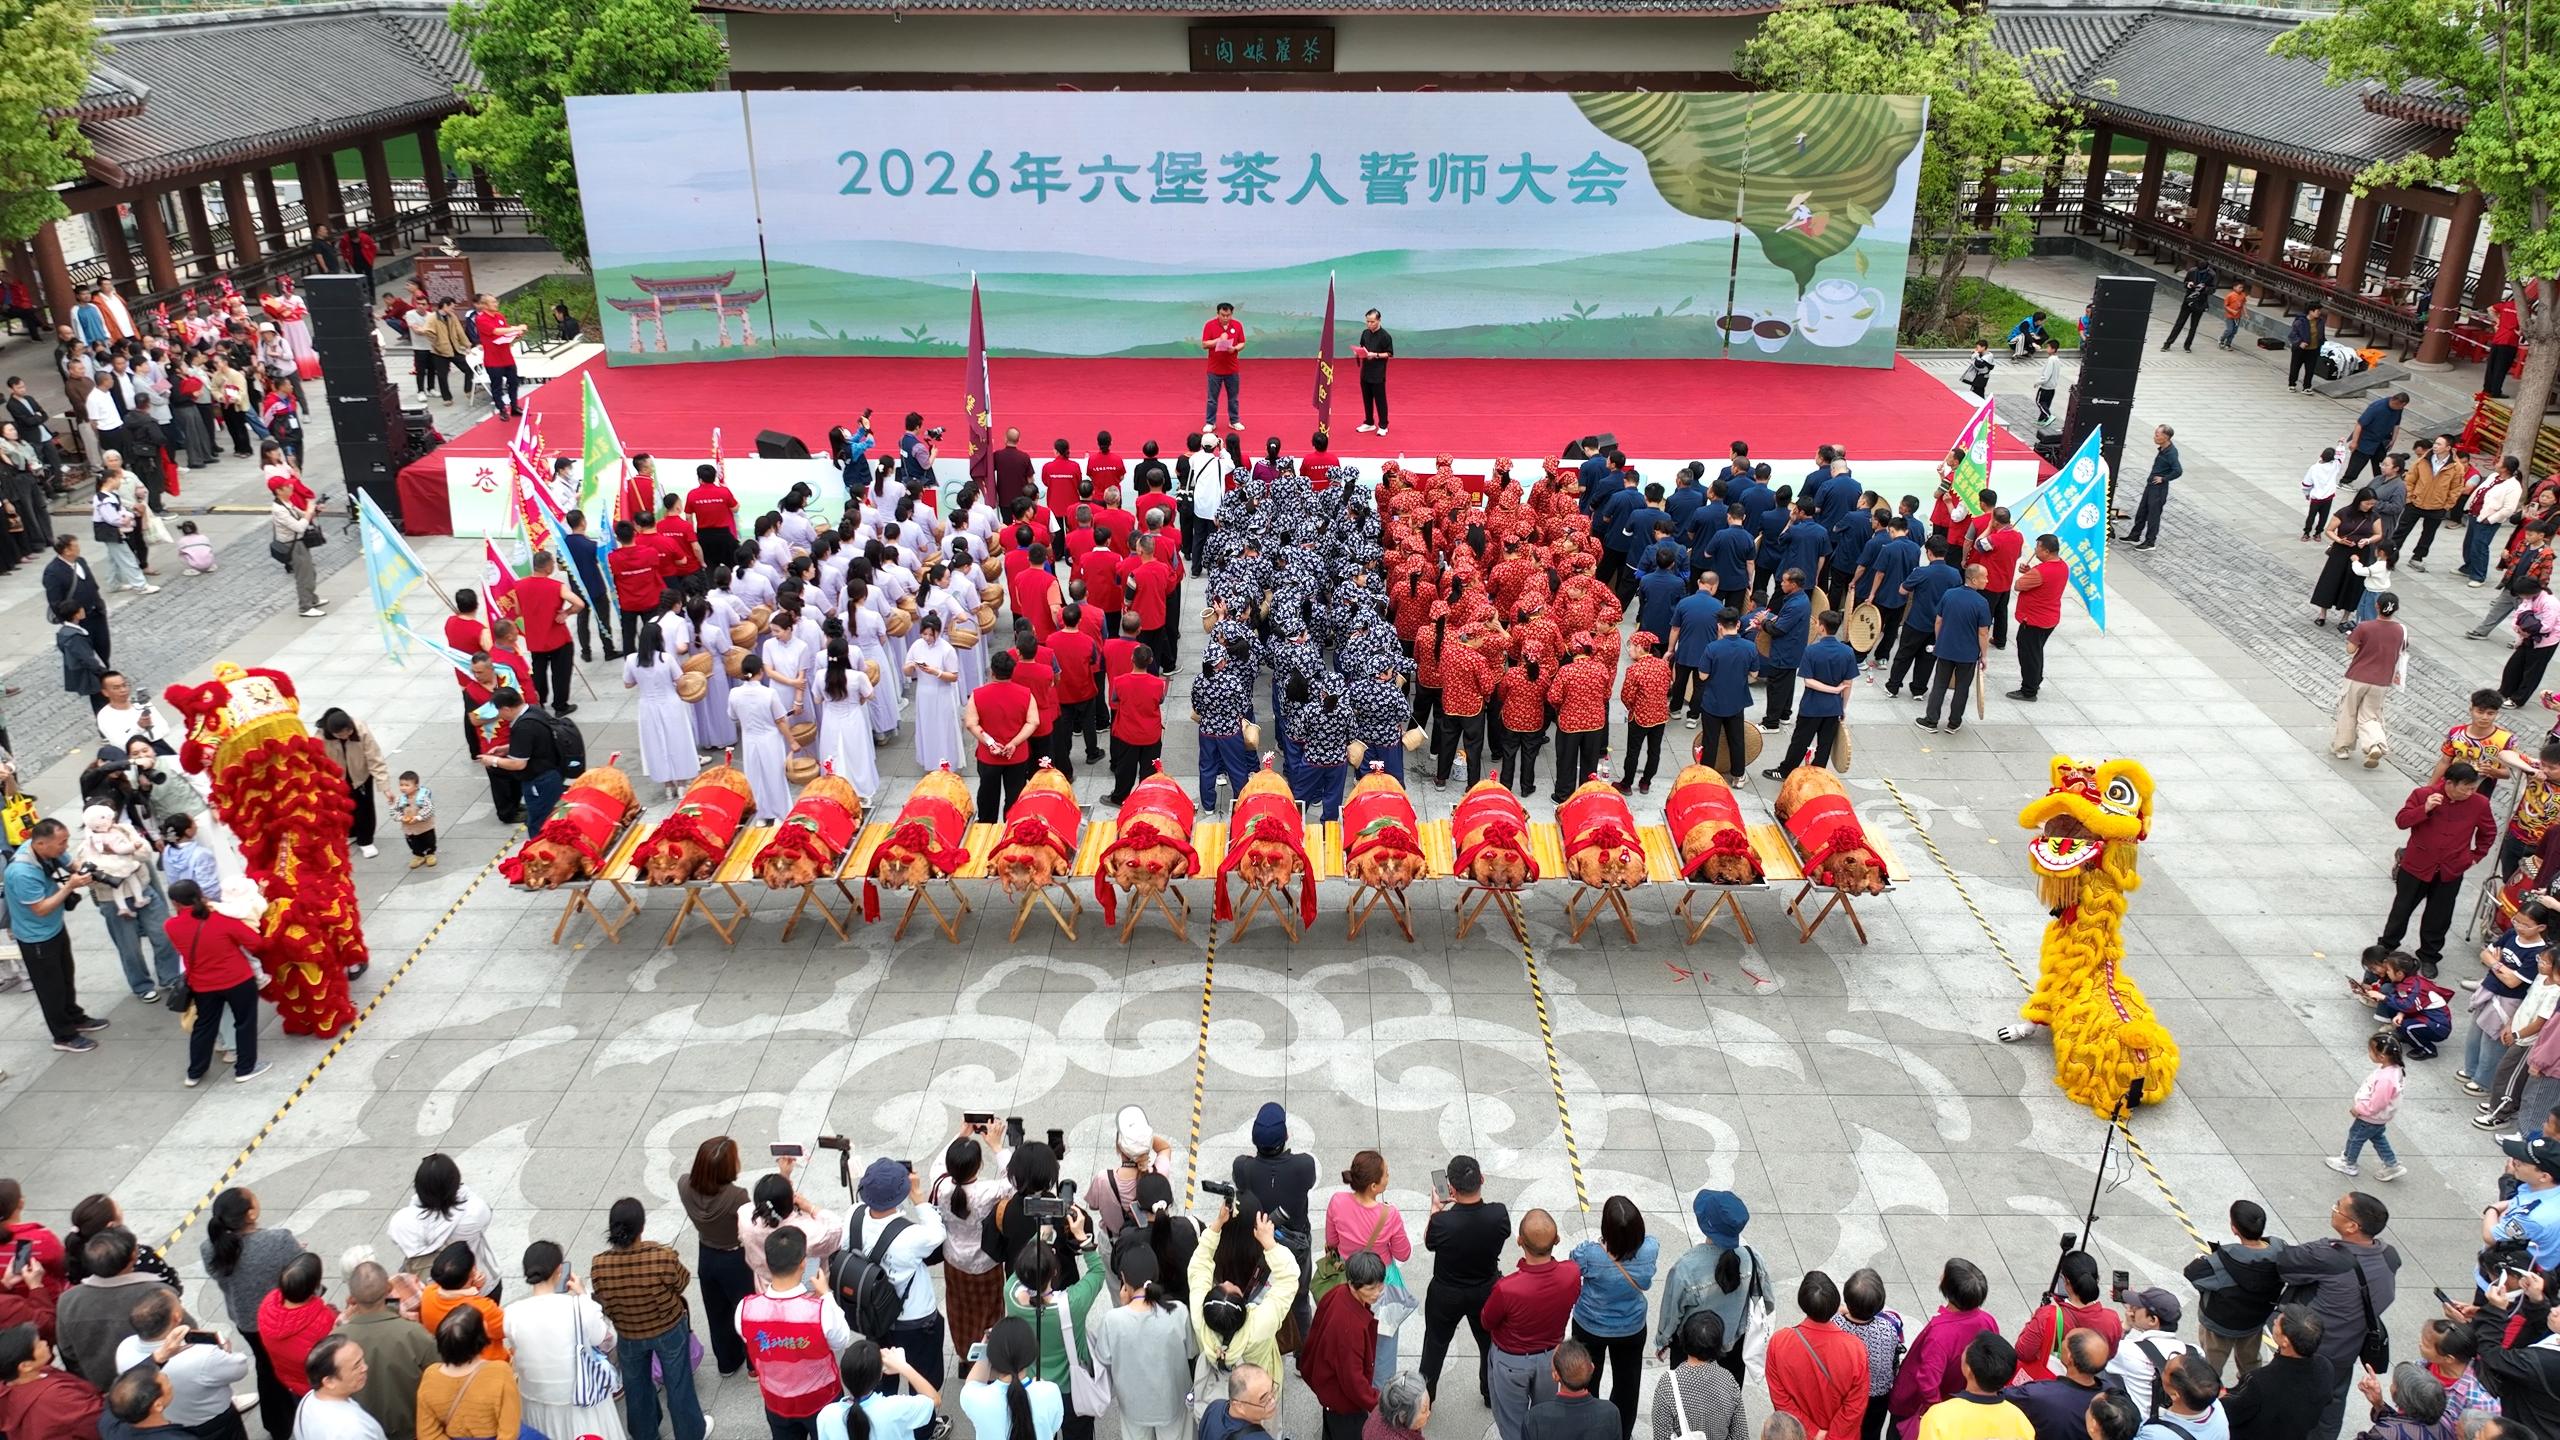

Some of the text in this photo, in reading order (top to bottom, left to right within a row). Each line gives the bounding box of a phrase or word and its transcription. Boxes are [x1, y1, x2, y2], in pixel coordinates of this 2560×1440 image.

[837, 148, 1629, 206] 2026年六堡茶人誓师大会
